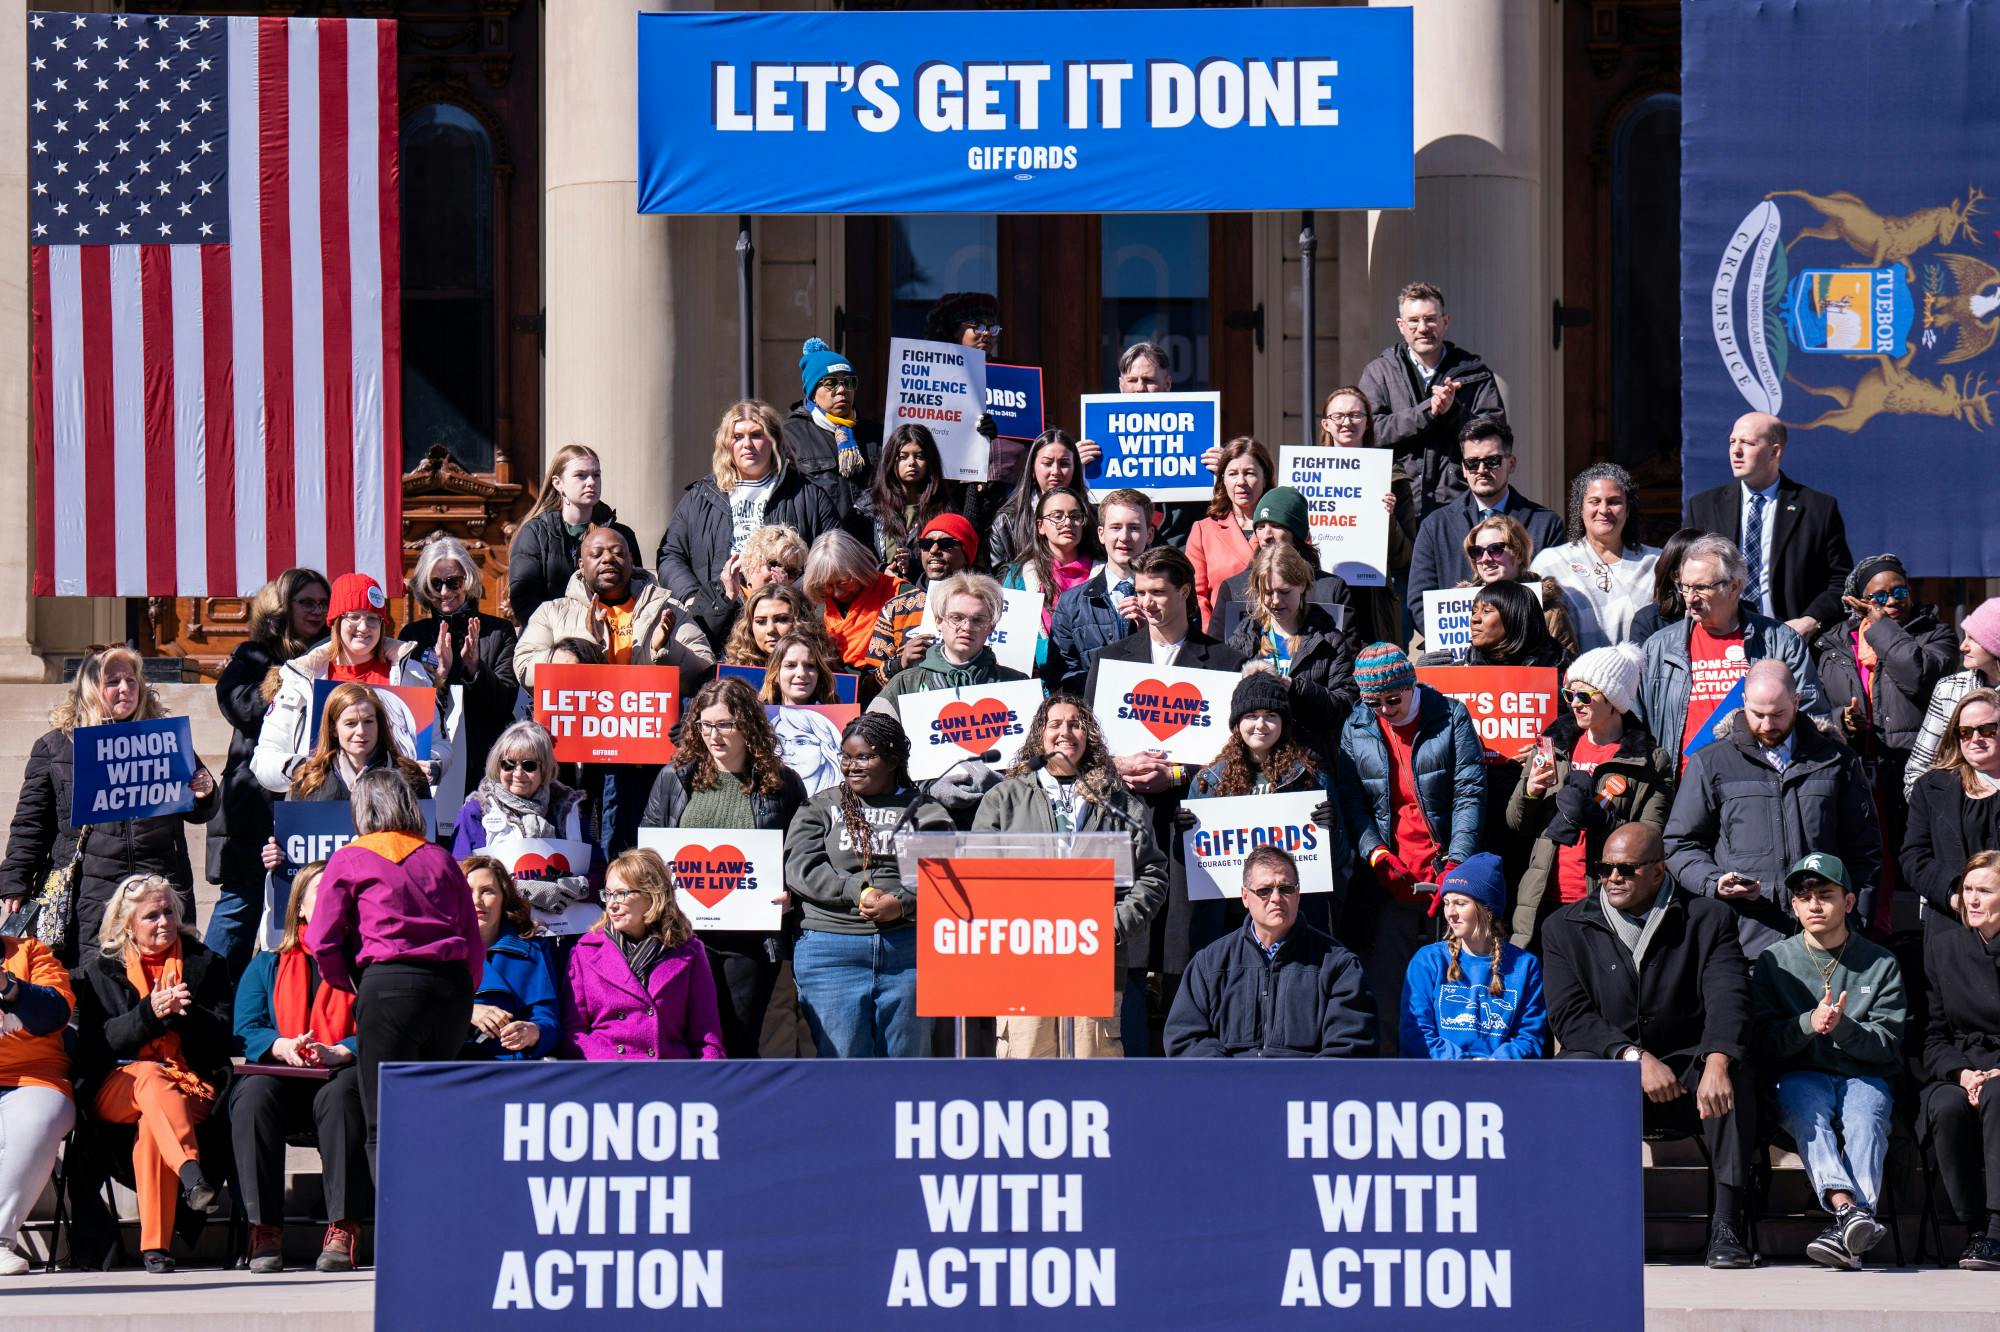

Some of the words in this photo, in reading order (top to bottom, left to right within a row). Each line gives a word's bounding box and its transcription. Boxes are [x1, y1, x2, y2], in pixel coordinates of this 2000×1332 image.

[713, 61, 899, 133] LET'S
[914, 61, 1051, 132] GET
[1064, 60, 1134, 130] IT
[1146, 57, 1339, 129] DONE
[967, 146, 1078, 171] GIFFORDS
[1715, 231, 1752, 388] CIRCUMSPICE
[1876, 269, 1894, 353] TUEBOR
[902, 349, 965, 367] FIGHTING
[901, 363, 930, 377] GUN
[900, 378, 967, 395] VIOLENCE
[900, 392, 943, 406] TAKES
[986, 388, 1026, 409] ORDS
[898, 405, 963, 423] COURAGE
[1108, 412, 1195, 434] HONOR
[1118, 433, 1184, 455] WITH
[1106, 454, 1198, 478] ACTION
[1292, 457, 1361, 470] FIGHTING
[1291, 471, 1322, 483] GUN
[1308, 500, 1336, 512] KES
[1309, 514, 1358, 527] URAGE
[1437, 599, 1473, 615] FIGH
[1438, 615, 1470, 630] GUN
[1438, 631, 1473, 646] VIOL
[1692, 668, 1749, 682] EMAN
[541, 689, 614, 713] LET'S
[619, 691, 673, 714] GET
[1123, 692, 1159, 708] GUN
[1162, 696, 1210, 713] LAWS
[1443, 692, 1495, 715] T'S
[1499, 692, 1551, 715] GET
[549, 714, 577, 738] IT
[581, 715, 662, 739] DONE!
[930, 715, 967, 732] GUN
[969, 710, 1018, 727] LAWS
[1117, 706, 1161, 723] SAVE
[1163, 711, 1212, 727] LIVES
[929, 729, 973, 746] SAVE
[975, 723, 1025, 740] LIVES
[97, 731, 179, 762] HONOR
[107, 757, 171, 786] WITH
[91, 781, 183, 813] ACTION
[287, 834, 360, 864] GIFF
[1195, 823, 1319, 857] GIFFORDS
[667, 860, 702, 874] GUN
[705, 861, 755, 874] LAWS
[1197, 859, 1232, 869] COURAGE
[1293, 853, 1319, 863] LENCE
[674, 876, 705, 890] AVE
[708, 877, 758, 890] LIVES
[933, 917, 1100, 955] GIFFORDS
[504, 1102, 722, 1163] HONOR
[893, 1100, 1112, 1161] HONOR
[1286, 1100, 1507, 1162] HONOR
[528, 1176, 692, 1236] WITH
[919, 1174, 1084, 1234] WITH
[1313, 1174, 1479, 1234] WITH
[492, 1249, 724, 1311] ACTION
[886, 1247, 1117, 1309] ACTION
[1280, 1247, 1513, 1309] ACTION
